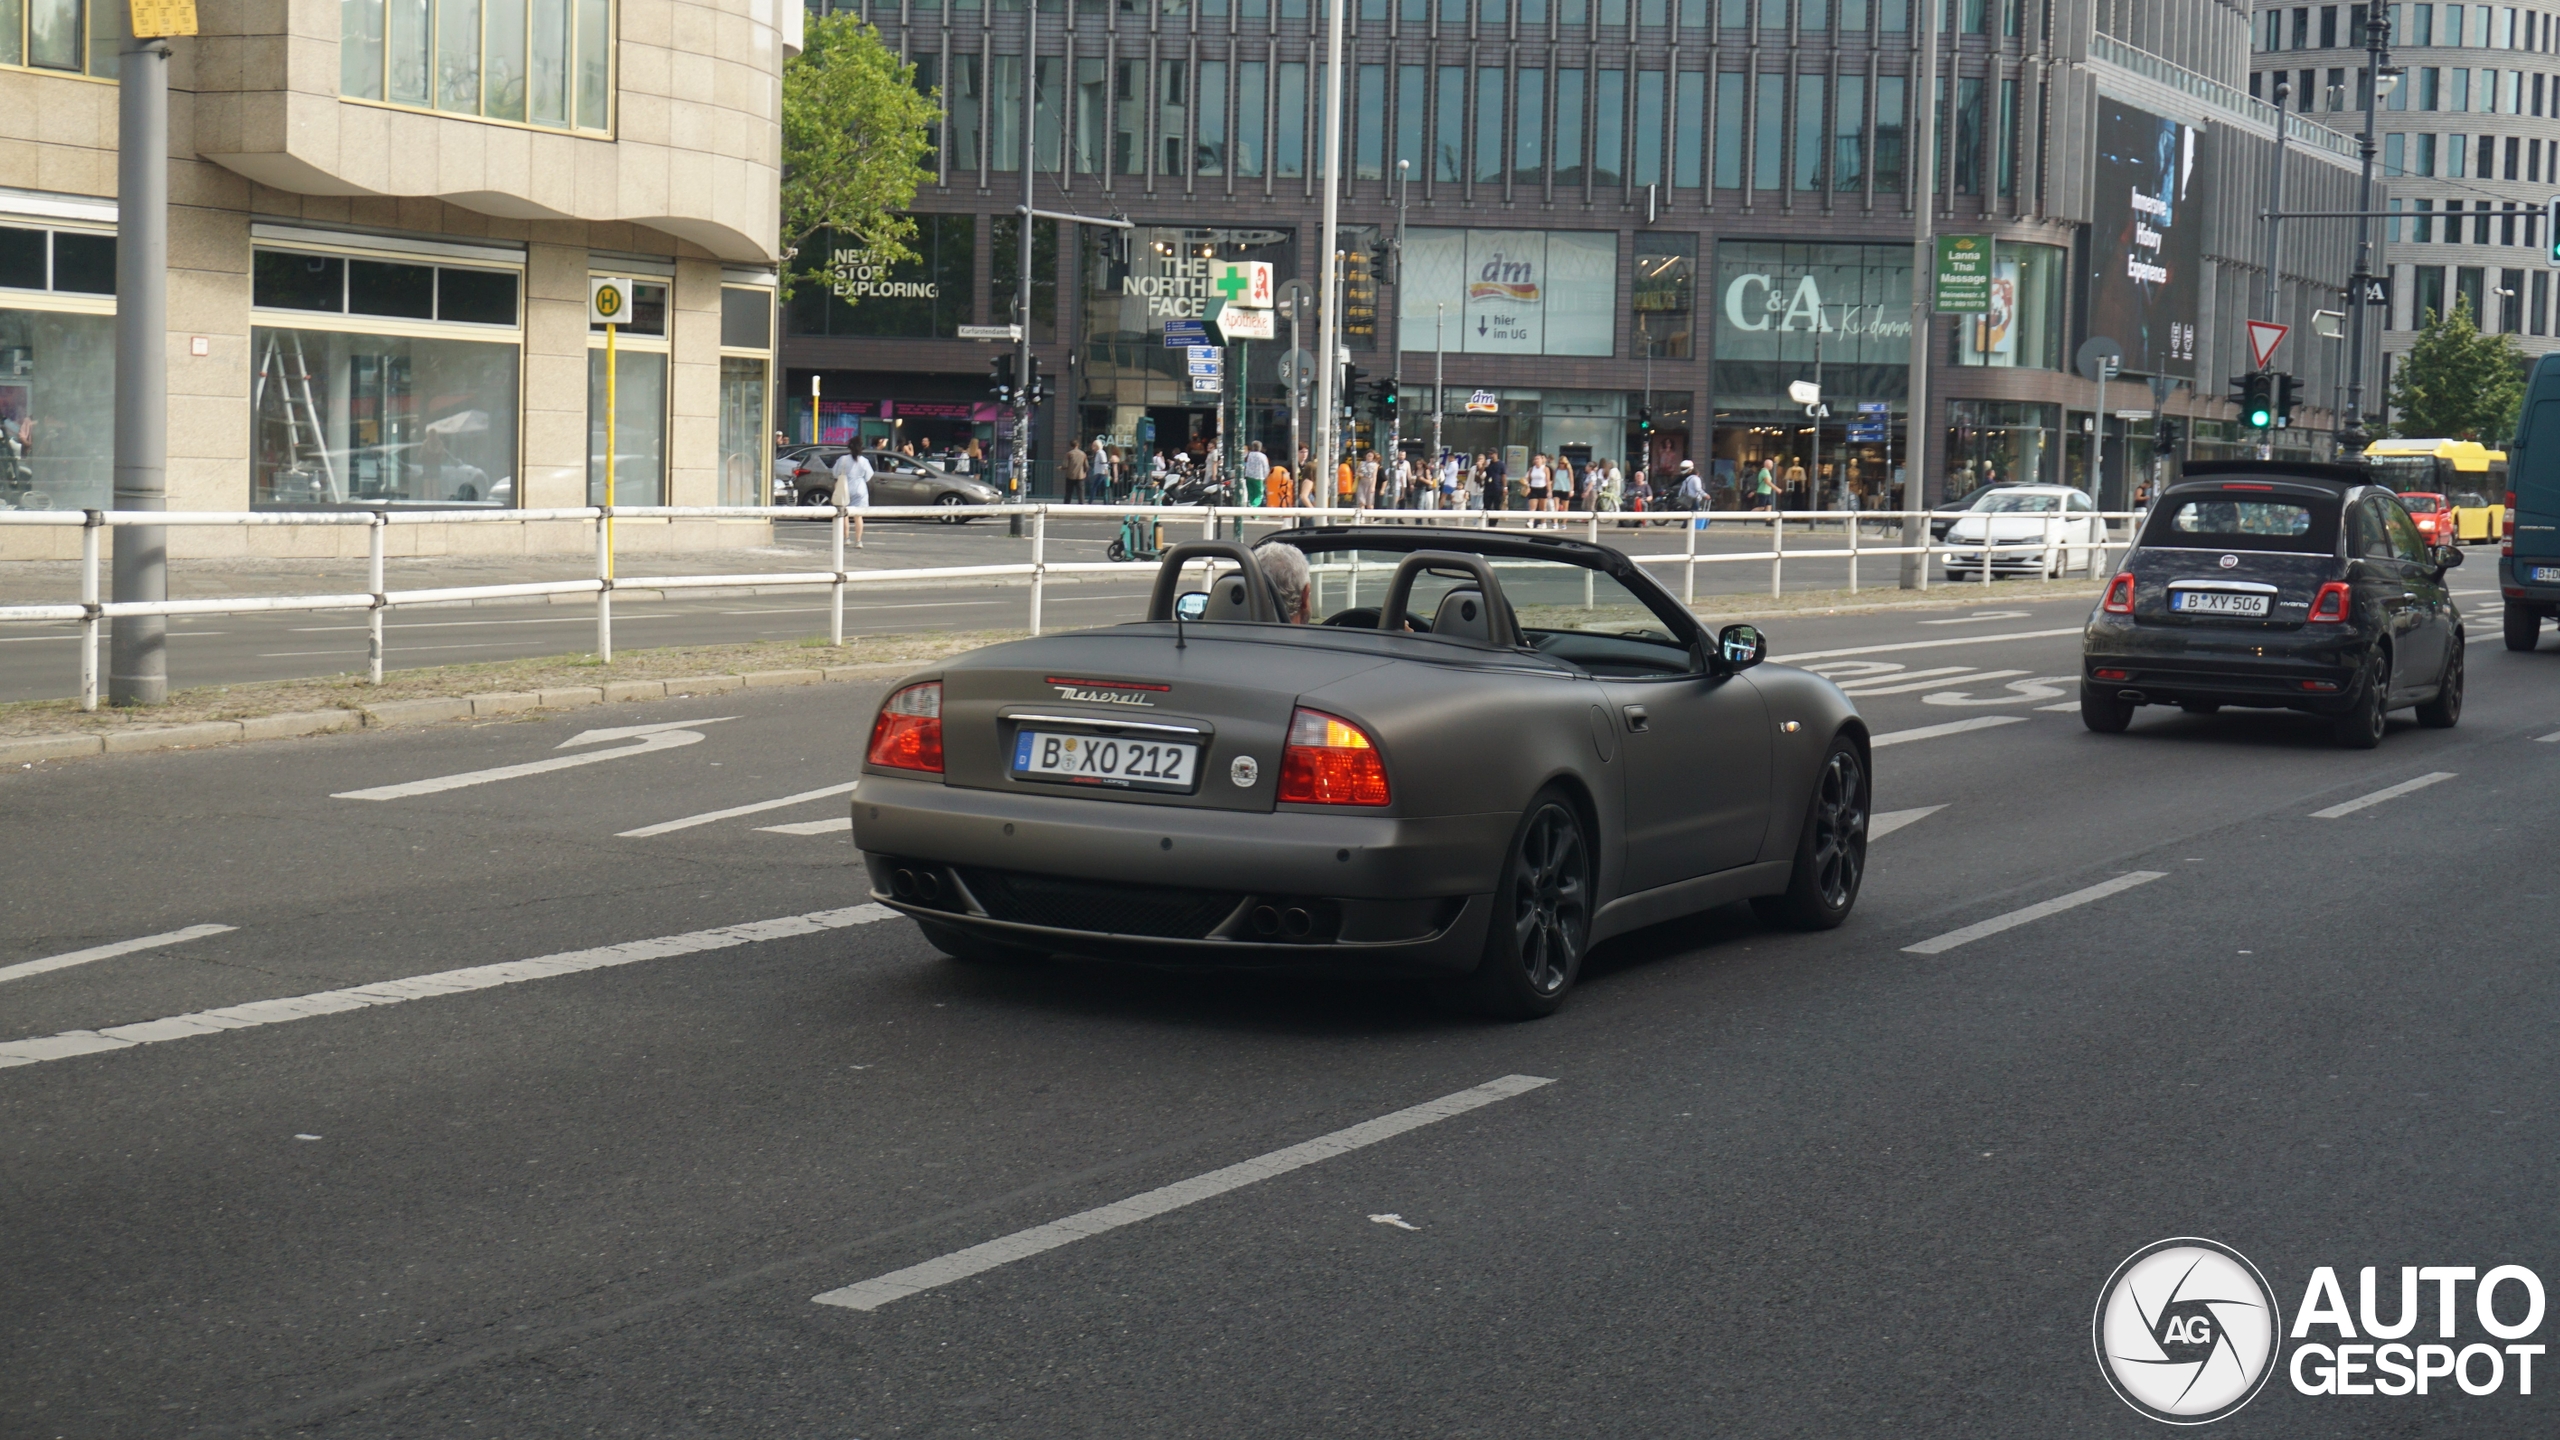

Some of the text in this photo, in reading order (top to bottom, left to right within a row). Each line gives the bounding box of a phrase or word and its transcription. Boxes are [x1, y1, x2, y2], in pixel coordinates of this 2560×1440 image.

[2131, 186, 2167, 217] Immersive
[2136, 221, 2162, 255] History
[1948, 250, 1981, 260] Lanna
[1160, 257, 1207, 277] THE
[1481, 252, 1532, 283] dm
[1952, 261, 1976, 271] Thai
[2127, 254, 2167, 284] Experience
[1122, 275, 1207, 297] NORTH
[1940, 273, 1987, 285] Massage
[833, 281, 939, 298] EXPLORING
[601, 292, 614, 310] H
[1148, 296, 1207, 318] FACE
[1725, 273, 1834, 333] C&A
[1224, 311, 1267, 329] Apotheke
[1494, 314, 1516, 326] hier
[1494, 328, 1527, 340] im UG
[1472, 391, 1493, 404] dm
[1096, 434, 1133, 447] SALE
[2538, 569, 2546, 579] B
[2188, 594, 2199, 608] B
[2208, 595, 2230, 610] XY
[2232, 597, 2262, 611] 506
[1054, 686, 1155, 707] Maserati
[1041, 737, 1061, 769] B
[1079, 740, 1118, 774] XO
[1125, 744, 1183, 780] 212
